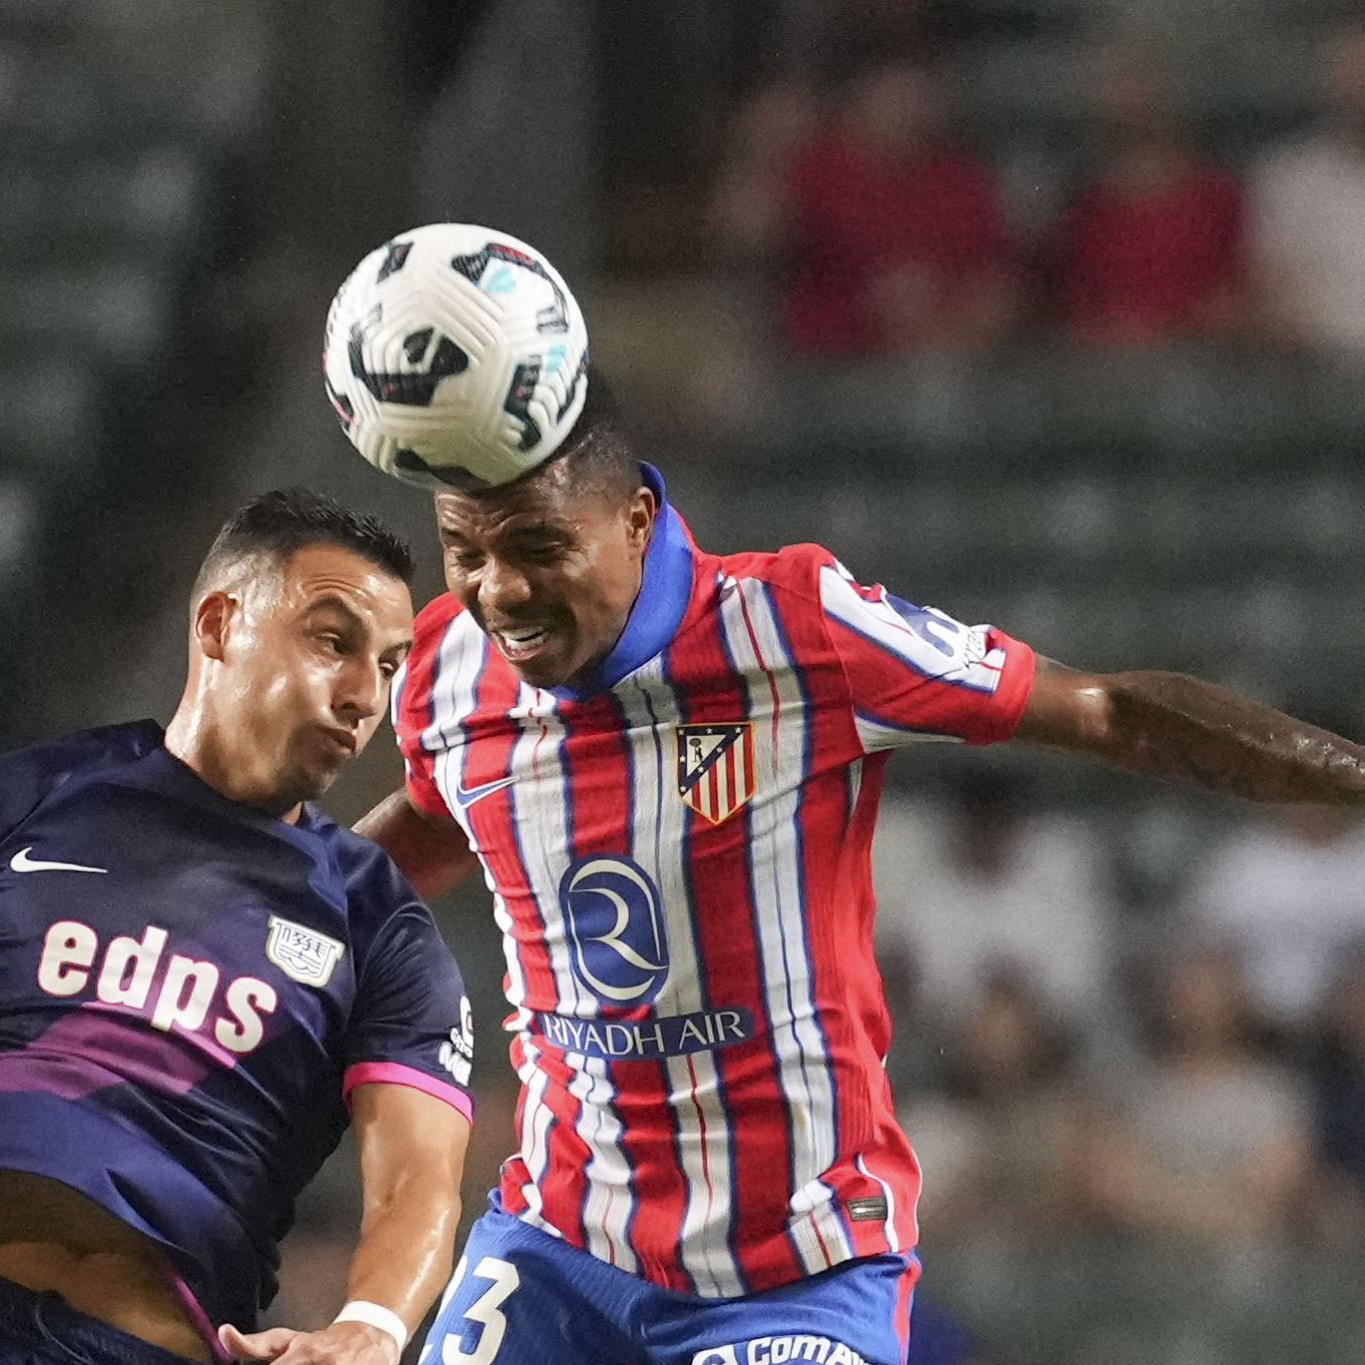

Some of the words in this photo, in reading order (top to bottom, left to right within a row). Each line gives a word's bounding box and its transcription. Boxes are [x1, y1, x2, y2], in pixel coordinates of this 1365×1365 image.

[36, 919, 277, 1054] edps
[543, 1014, 665, 1056] RIYADH
[679, 1010, 746, 1050] AIR
